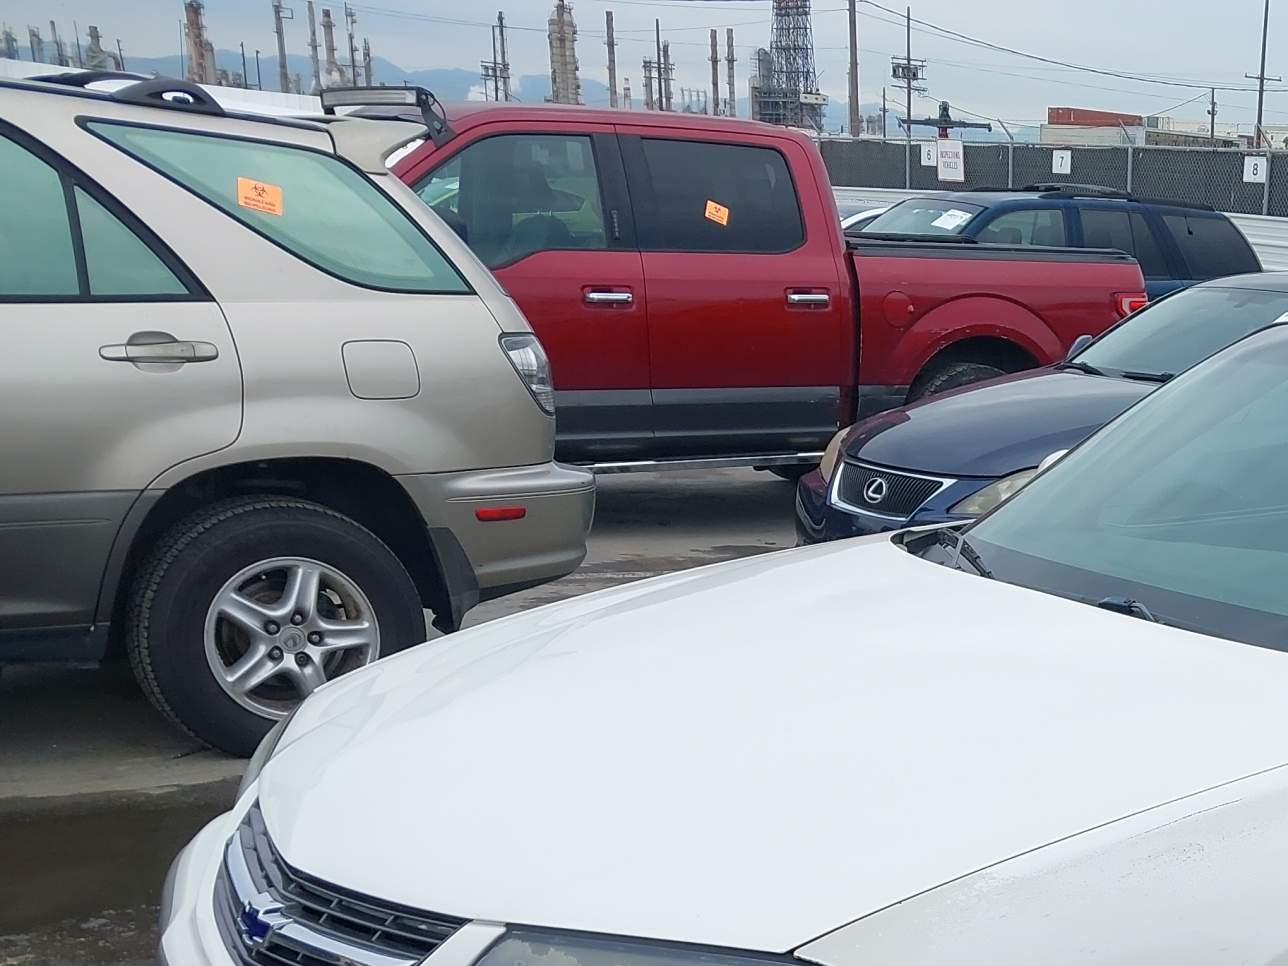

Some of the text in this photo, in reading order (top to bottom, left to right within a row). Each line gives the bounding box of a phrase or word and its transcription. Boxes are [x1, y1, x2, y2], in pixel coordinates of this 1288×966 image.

[926, 150, 931, 160] 6
[1060, 156, 1065, 168] 7
[1252, 162, 1259, 177] 8
